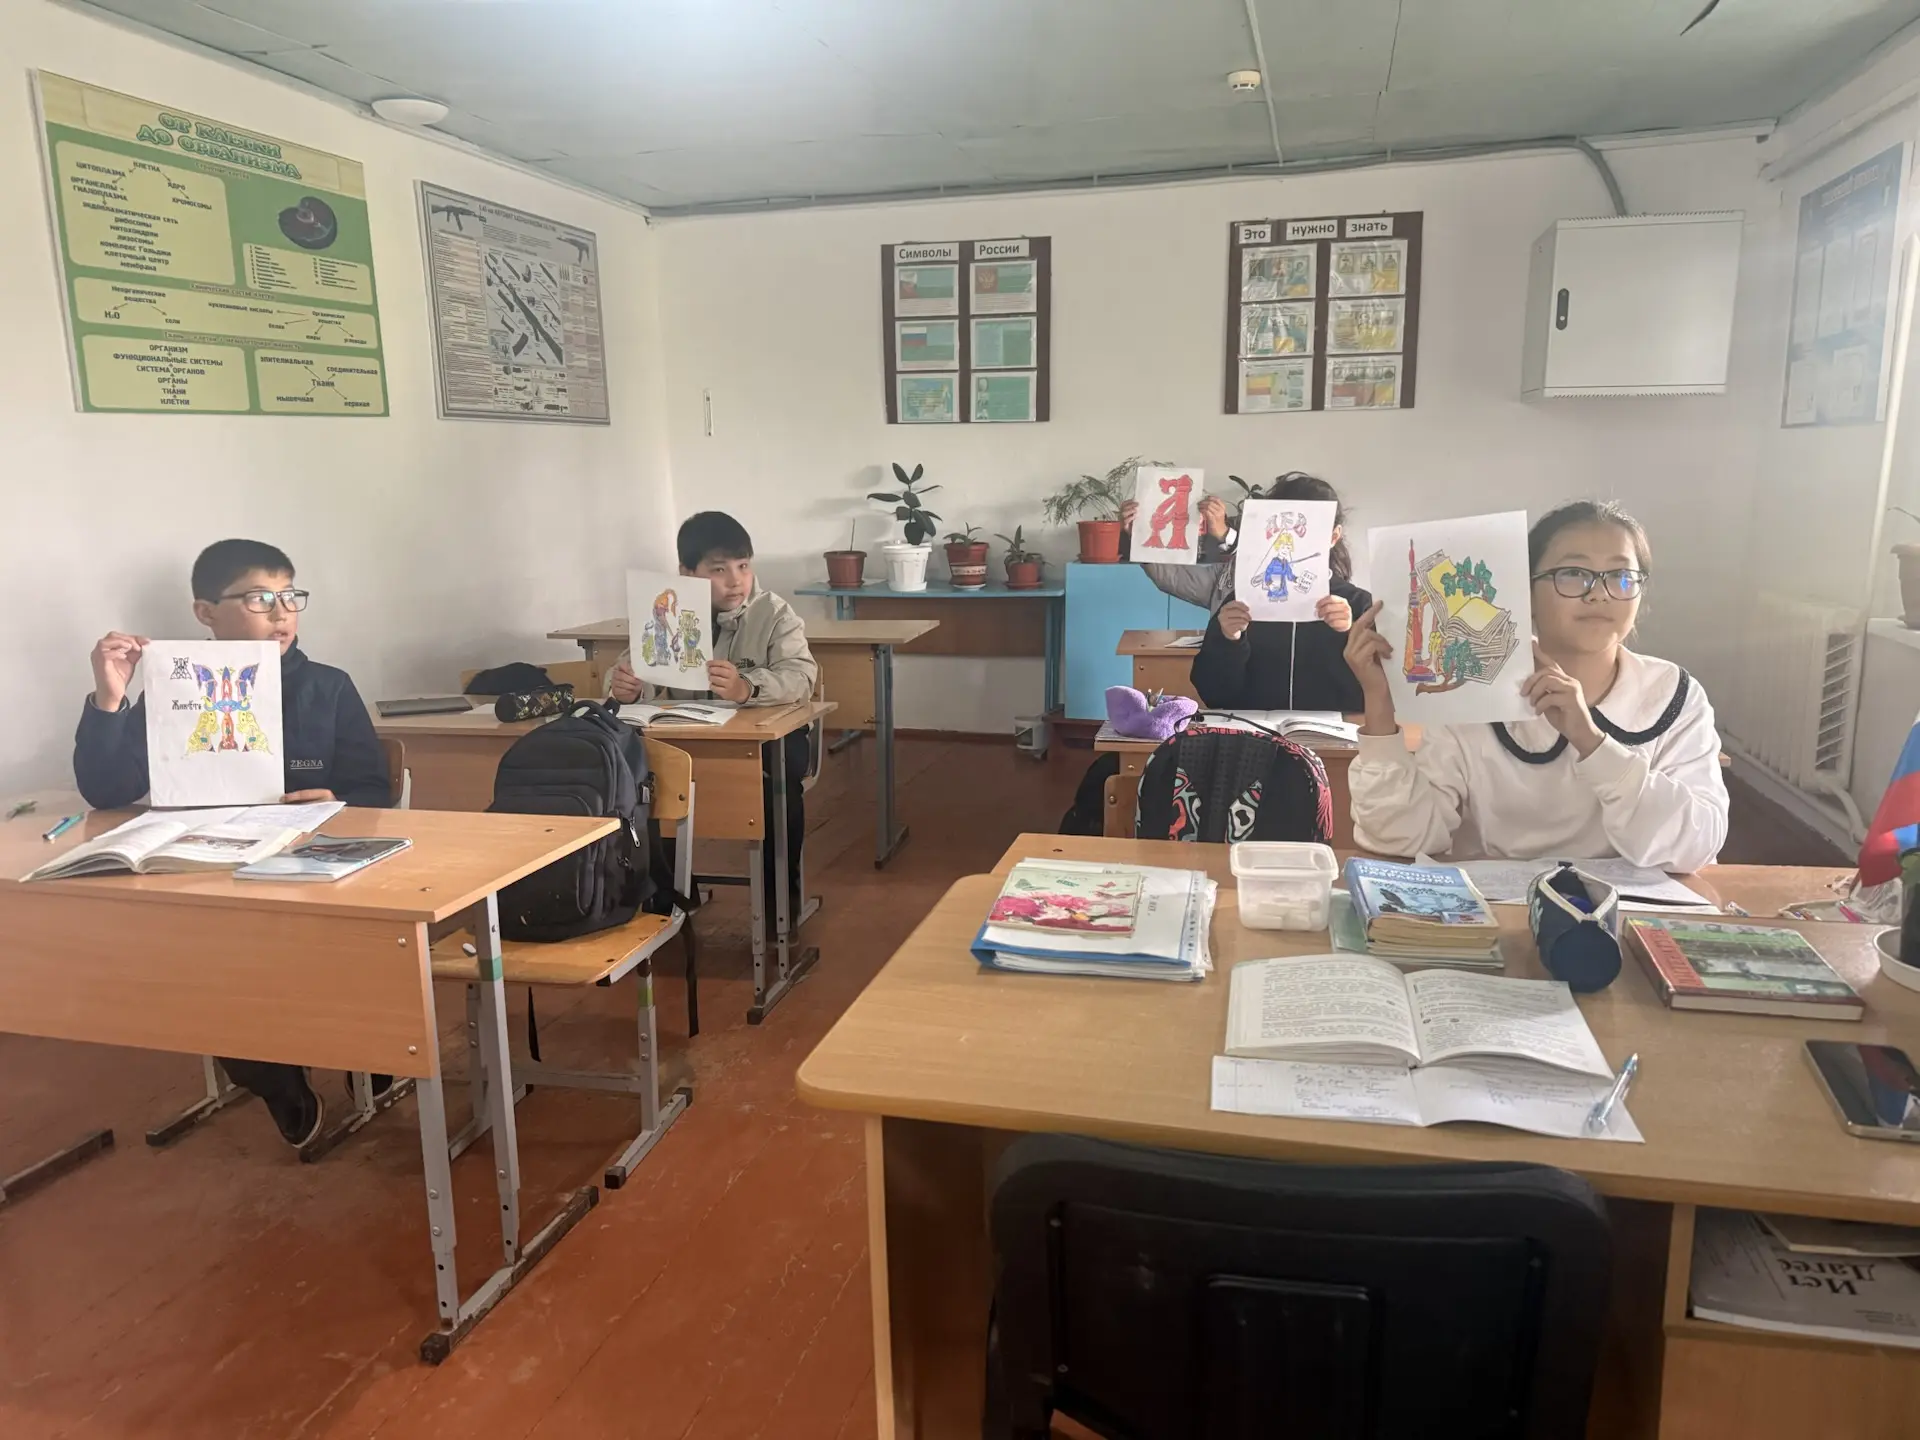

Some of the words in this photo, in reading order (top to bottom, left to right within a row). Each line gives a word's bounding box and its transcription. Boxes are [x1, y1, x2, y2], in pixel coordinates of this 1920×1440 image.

[158, 112, 192, 134] ОТ
[136, 124, 174, 146] ДО
[177, 135, 302, 180] ОРГАНИЗМА
[76, 161, 126, 177] ЦИТОПЛАЗМА
[70, 176, 118, 191] ОРГАНЕЛЛЫ
[167, 181, 186, 191] ЯДРО
[172, 197, 212, 210] ХРОМОСОМЫ
[1244, 228, 1266, 240] Это
[1292, 223, 1335, 237] нужно
[1351, 221, 1388, 233] знать
[100, 240, 136, 251] комплекс
[117, 235, 154, 245] лизосомы
[104, 251, 146, 261] клеточный
[148, 257, 170, 266] центр
[899, 248, 952, 260] Символы
[979, 244, 1020, 256] России
[120, 261, 157, 271] мембрана
[111, 285, 166, 298] Неорганические
[149, 344, 188, 353] ОРГАНИЗМ
[113, 353, 187, 364] ФУНКЦИОНАЛЬНЫЕ
[189, 358, 223, 366] СИСТЕМЫ
[136, 365, 170, 373] СИСТЕМА
[173, 367, 205, 375] ОРГАНОВ
[290, 759, 323, 768] ZEGNA
